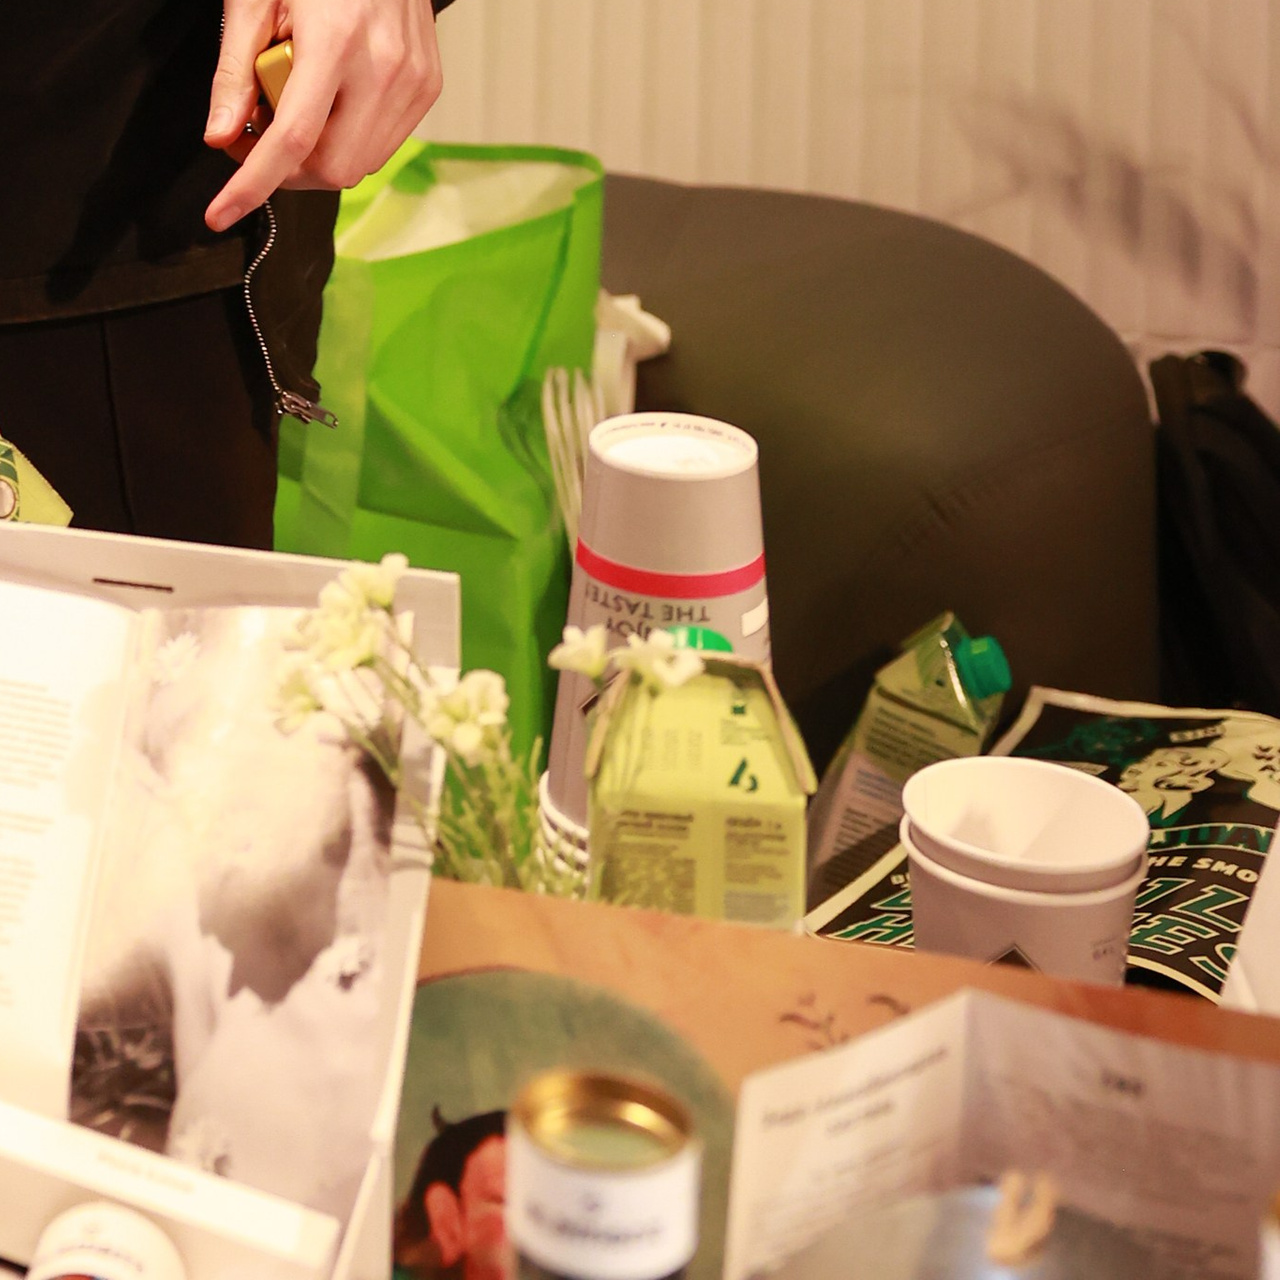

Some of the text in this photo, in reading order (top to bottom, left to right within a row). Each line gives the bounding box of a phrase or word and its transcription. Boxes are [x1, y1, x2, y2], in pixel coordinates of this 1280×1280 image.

[585, 583, 711, 622] THE TASTE!
[1147, 856, 1259, 883] HE SMO
